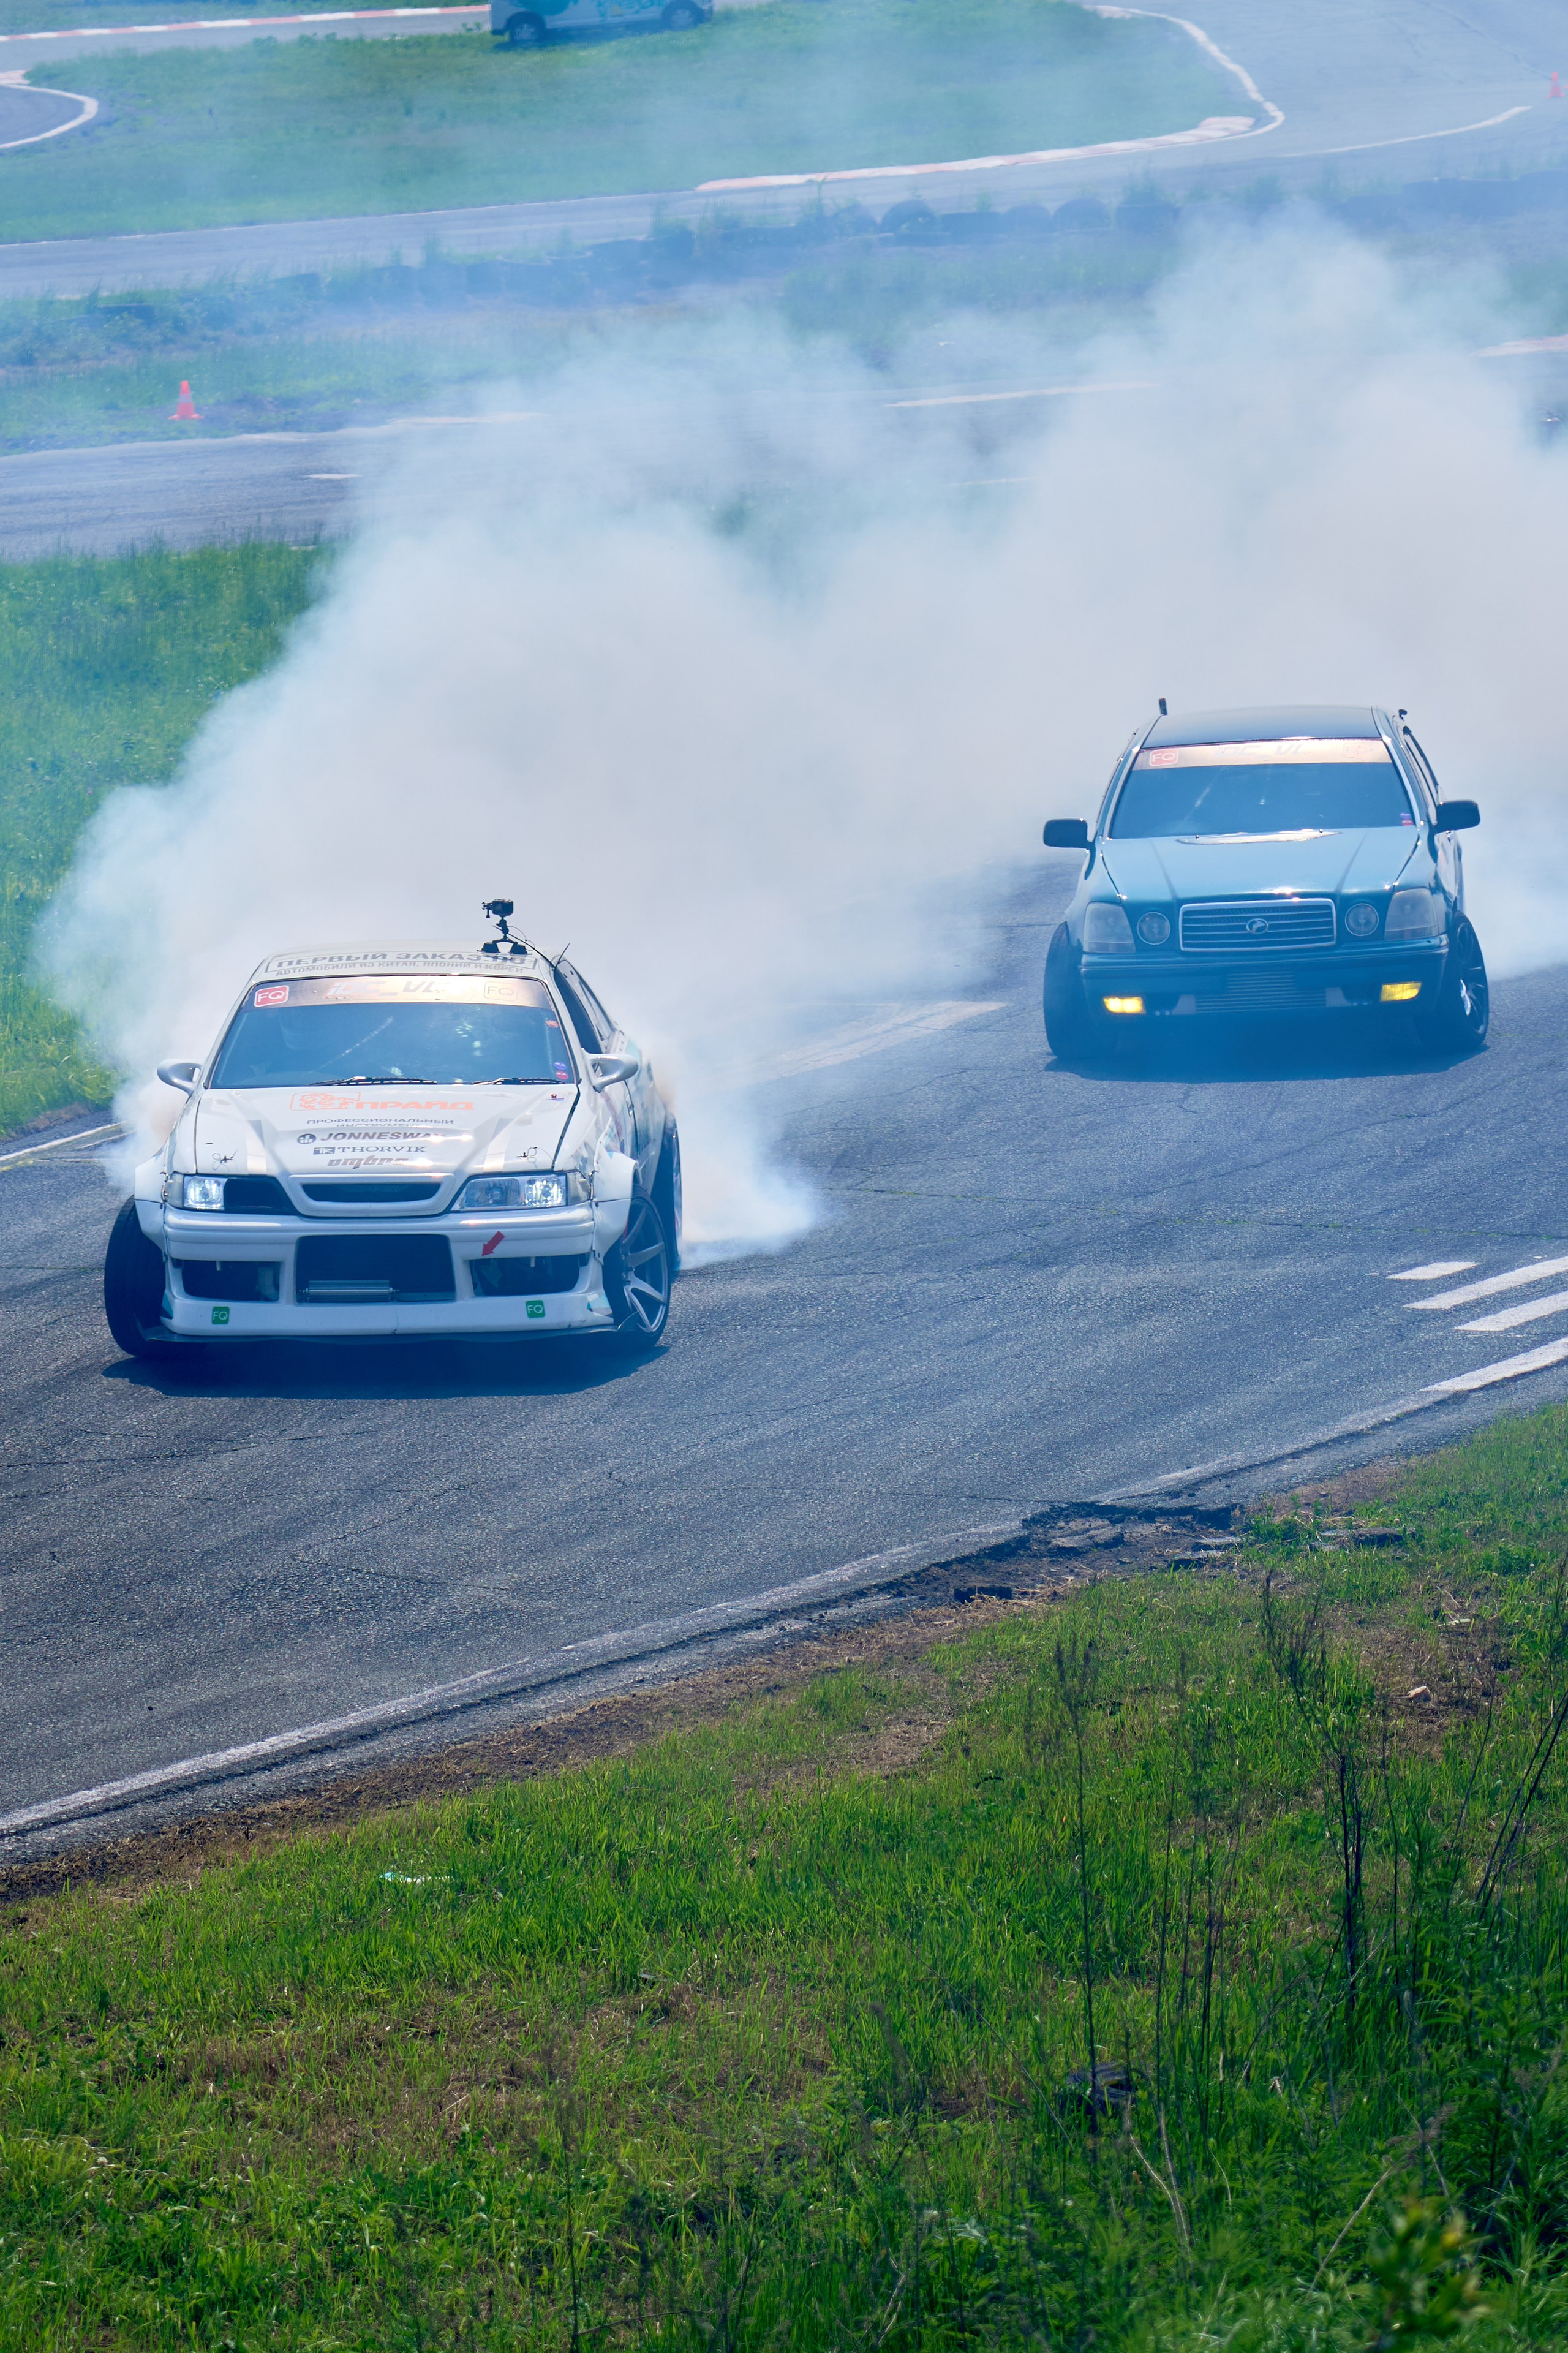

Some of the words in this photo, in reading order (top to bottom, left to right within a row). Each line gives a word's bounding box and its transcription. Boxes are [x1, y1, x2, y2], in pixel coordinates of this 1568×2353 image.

[277, 953, 387, 967] ПЕРВЫЙ
[276, 963, 355, 976] АВТОМОБИЛИ
[487, 986, 514, 996] FQ
[258, 991, 285, 1002] FQ
[355, 1101, 474, 1110] ПРАЙД
[320, 1132, 447, 1141] JONNESWA
[528, 1304, 544, 1314] FQ
[213, 1311, 228, 1320] FQ
